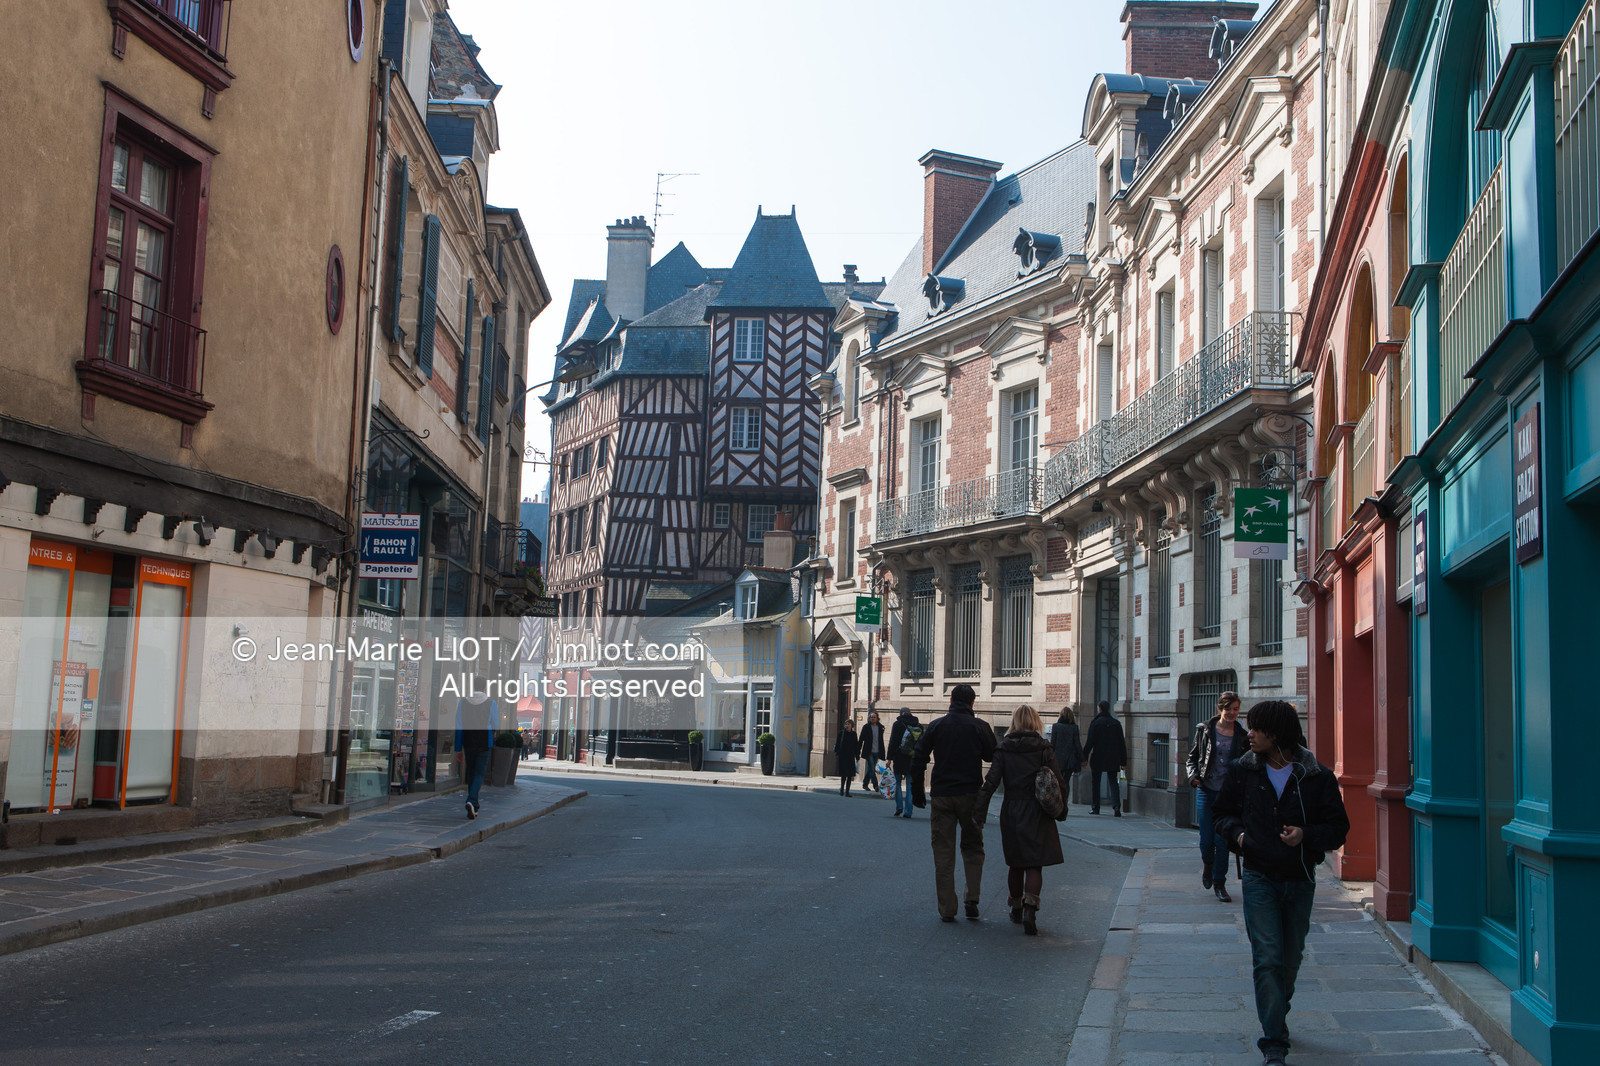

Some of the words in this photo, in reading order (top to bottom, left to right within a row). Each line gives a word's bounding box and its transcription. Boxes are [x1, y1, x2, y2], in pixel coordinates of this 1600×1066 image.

[1518, 422, 1532, 462] KAKI
[1517, 463, 1535, 505] CRAZY
[364, 518, 418, 526] MAJUSCULE
[1516, 506, 1539, 549] STATION
[373, 538, 406, 546] BAHON
[66, 552, 73, 562] &
[142, 563, 191, 579] TECHNIQUES
[365, 564, 412, 574] Papeterie
[362, 608, 393, 634] PAPETERIE
